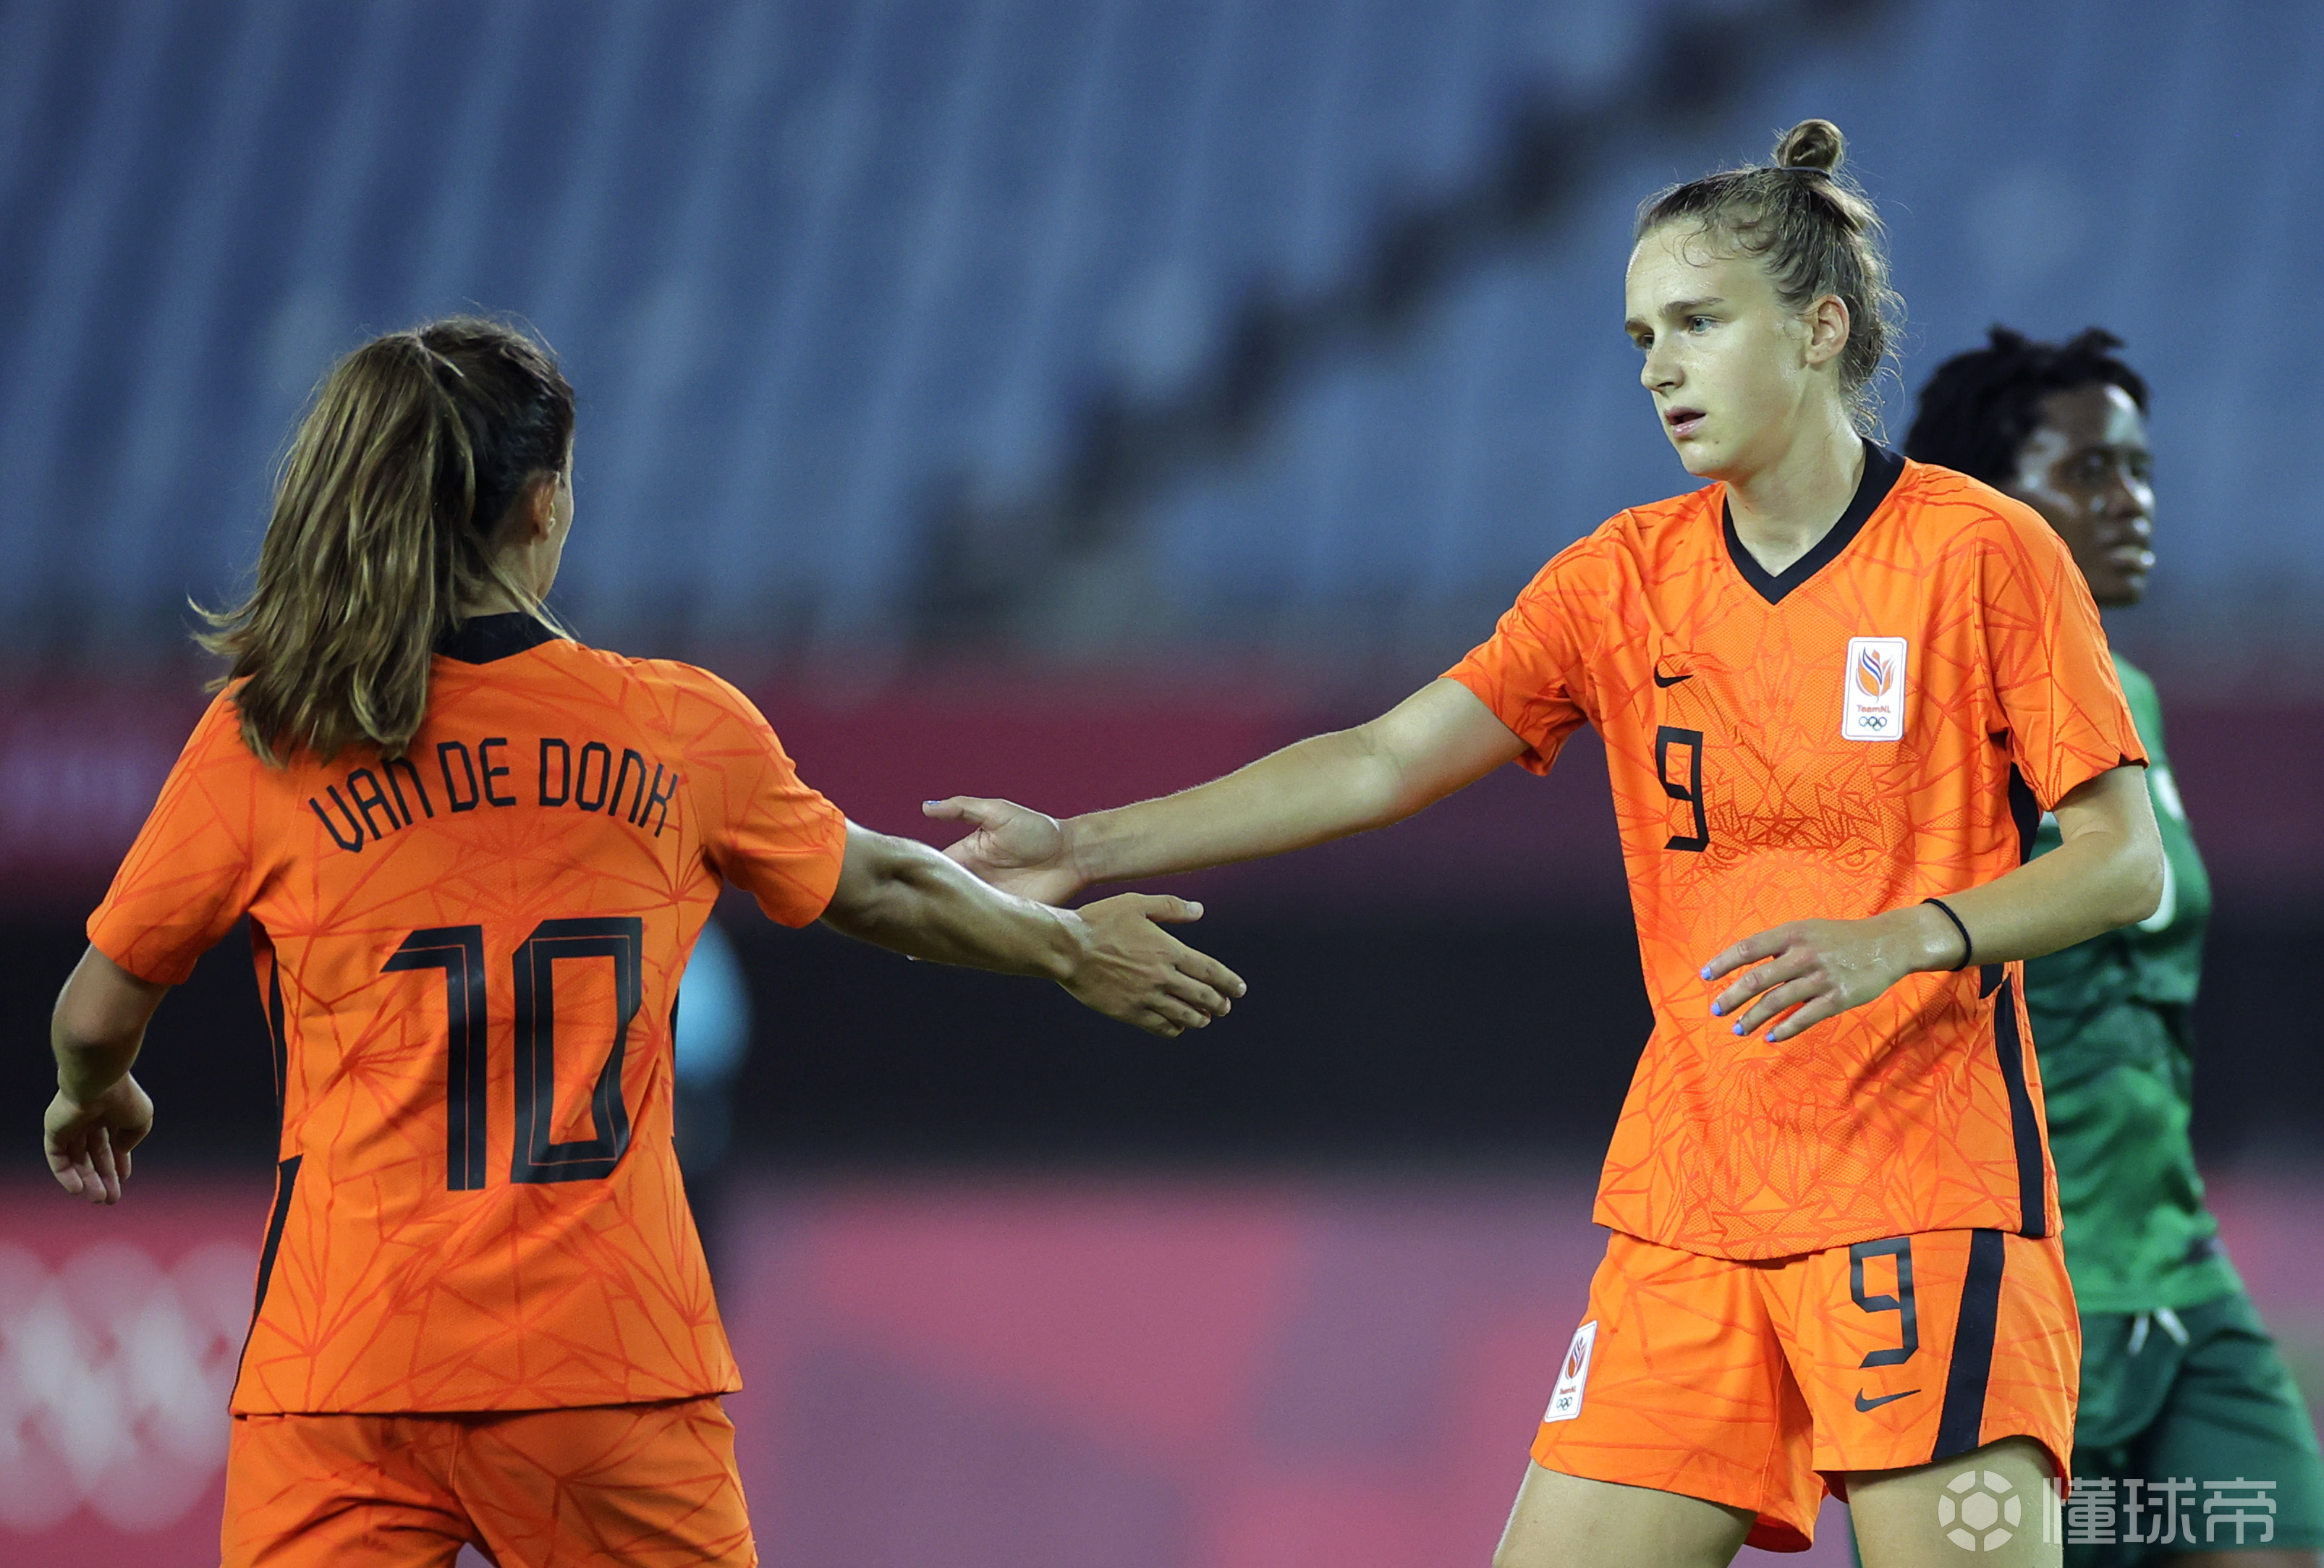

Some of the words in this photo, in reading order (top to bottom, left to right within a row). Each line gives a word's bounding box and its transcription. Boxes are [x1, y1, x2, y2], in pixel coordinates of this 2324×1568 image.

[1857, 704, 1891, 713] TeamNL
[308, 757, 434, 853] VAN
[437, 737, 517, 813] DE
[538, 737, 678, 838] DONK
[1655, 726, 1710, 852] 9
[380, 917, 643, 1192] 10
[1849, 1236, 1920, 1370] 9
